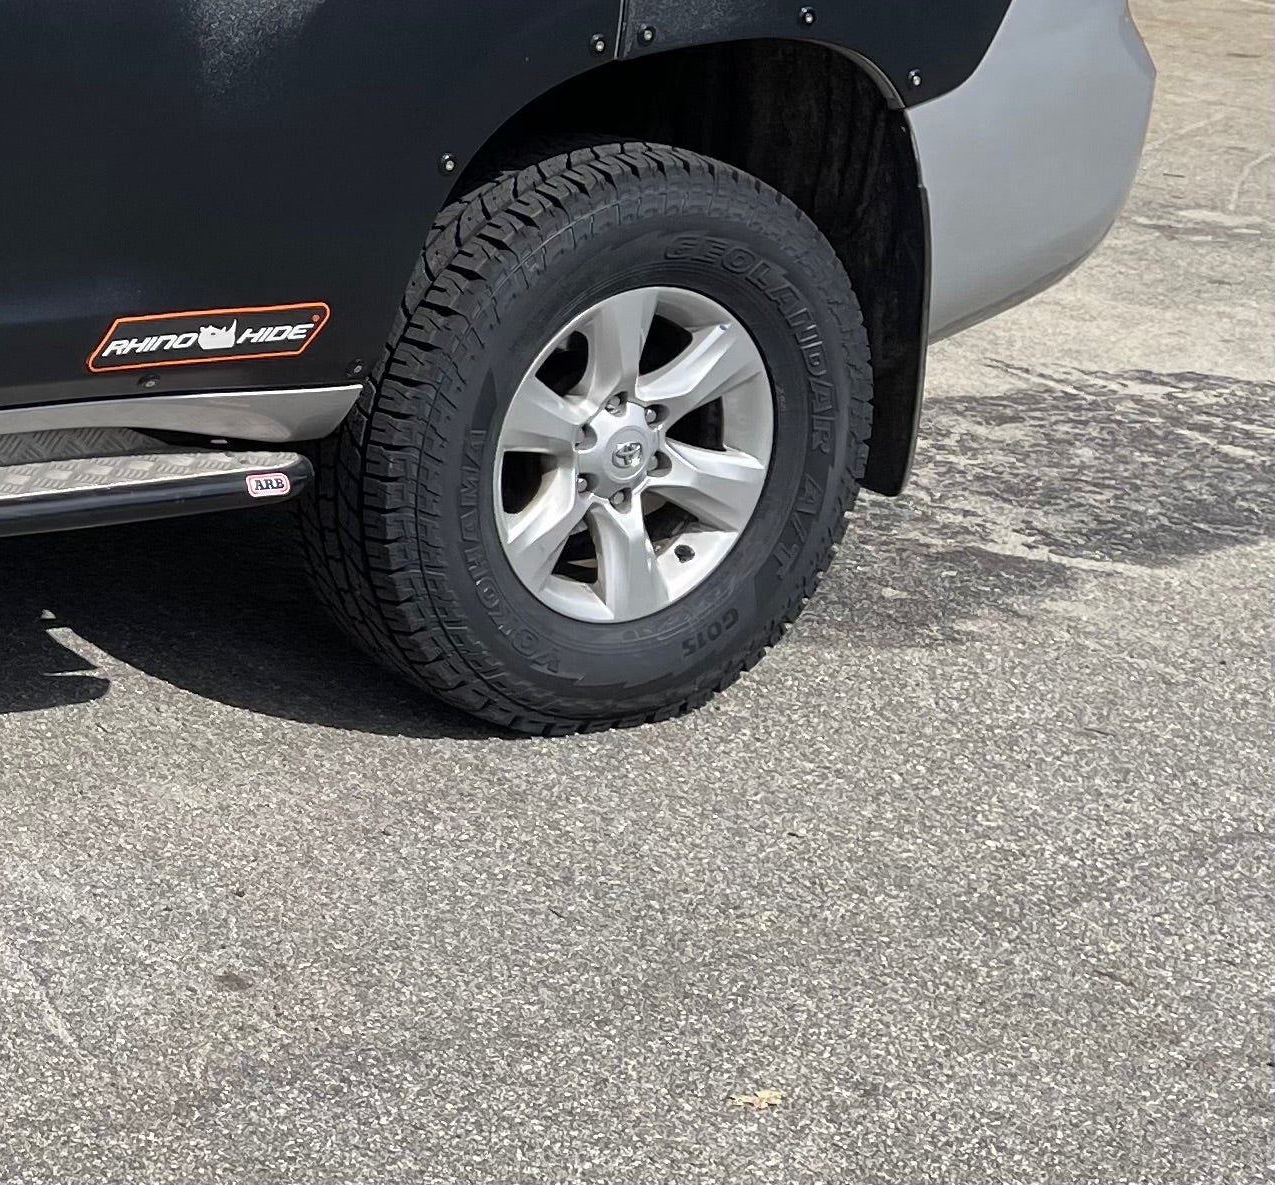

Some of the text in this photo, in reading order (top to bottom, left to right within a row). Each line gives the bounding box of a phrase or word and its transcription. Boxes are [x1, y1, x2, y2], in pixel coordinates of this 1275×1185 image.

[101, 323, 315, 357] RHINO HIDE
[254, 477, 285, 491] ARB
